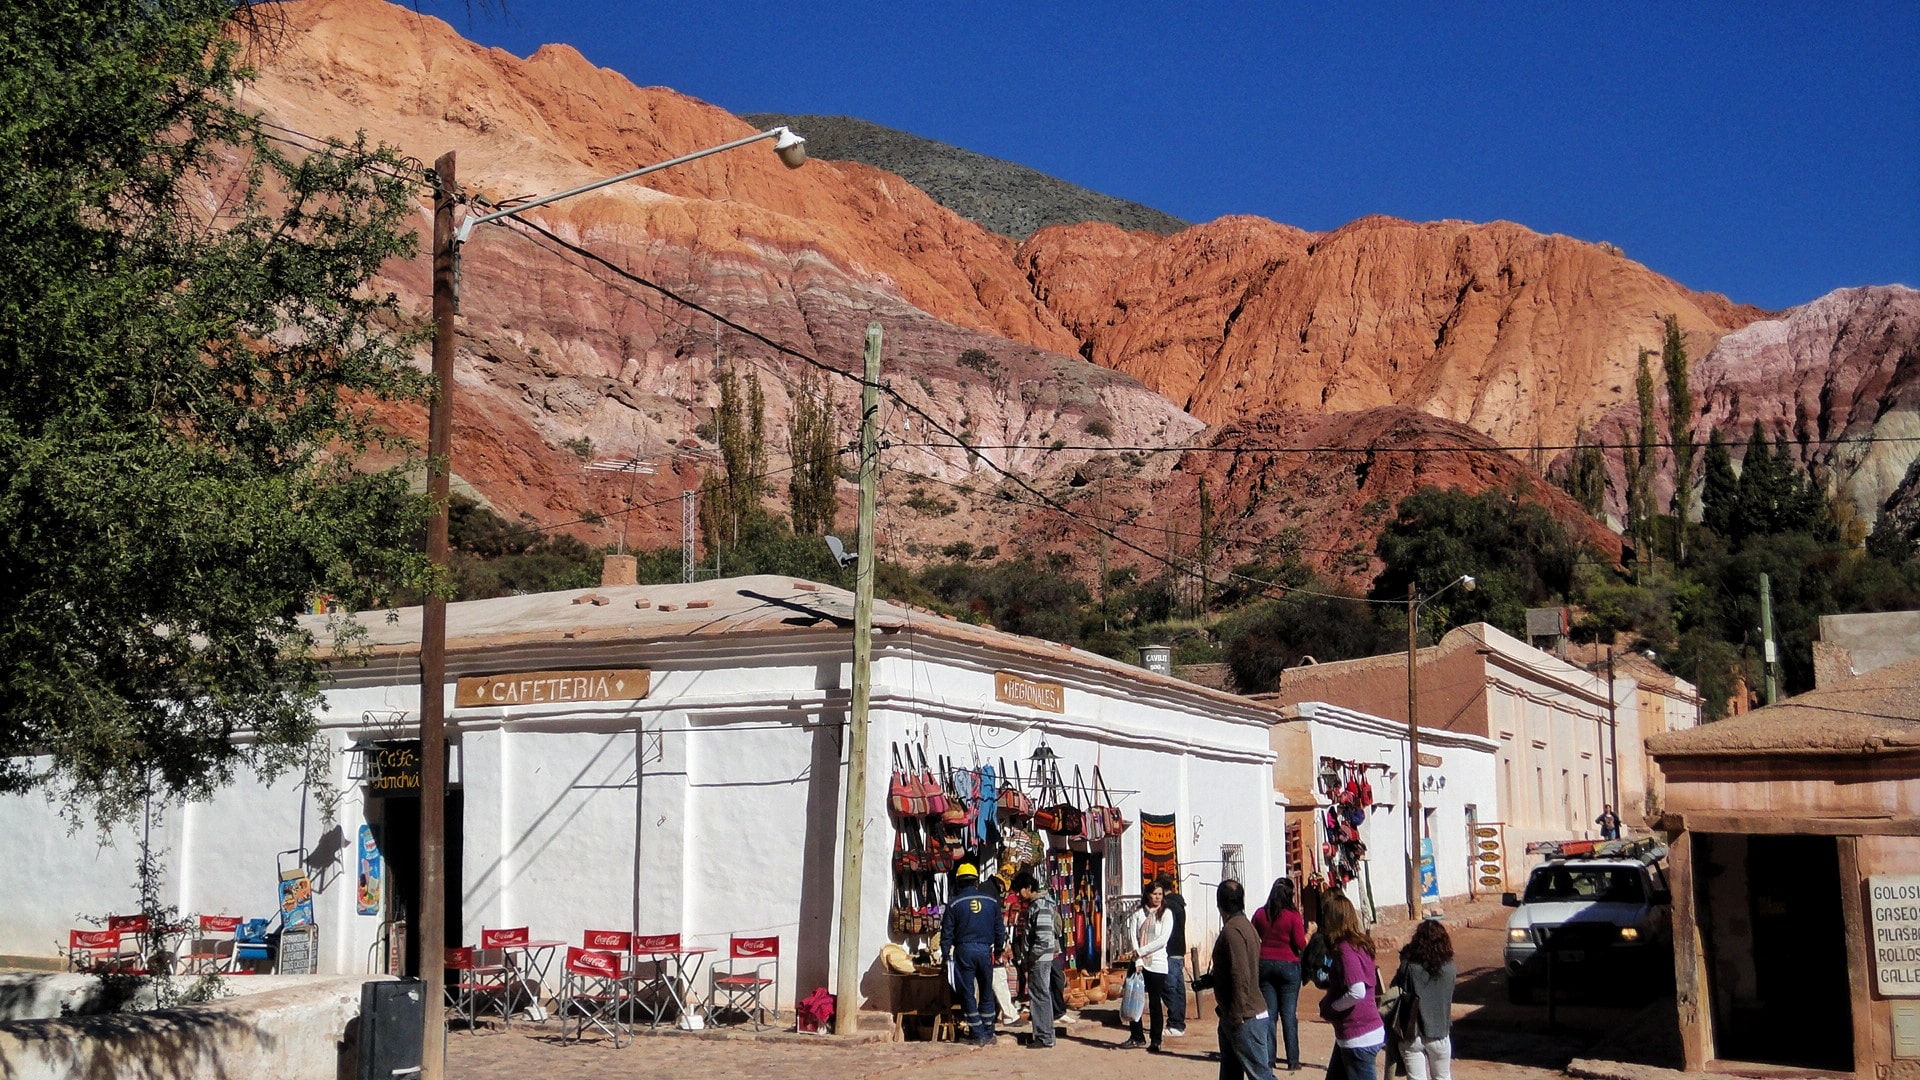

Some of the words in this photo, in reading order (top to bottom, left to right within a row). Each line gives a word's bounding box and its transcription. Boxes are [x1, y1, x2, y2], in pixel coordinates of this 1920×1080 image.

[492, 676, 610, 702] CAFETERIA
[1008, 680, 1056, 708] REGIONALES
[1876, 906, 1920, 921] GASEO
